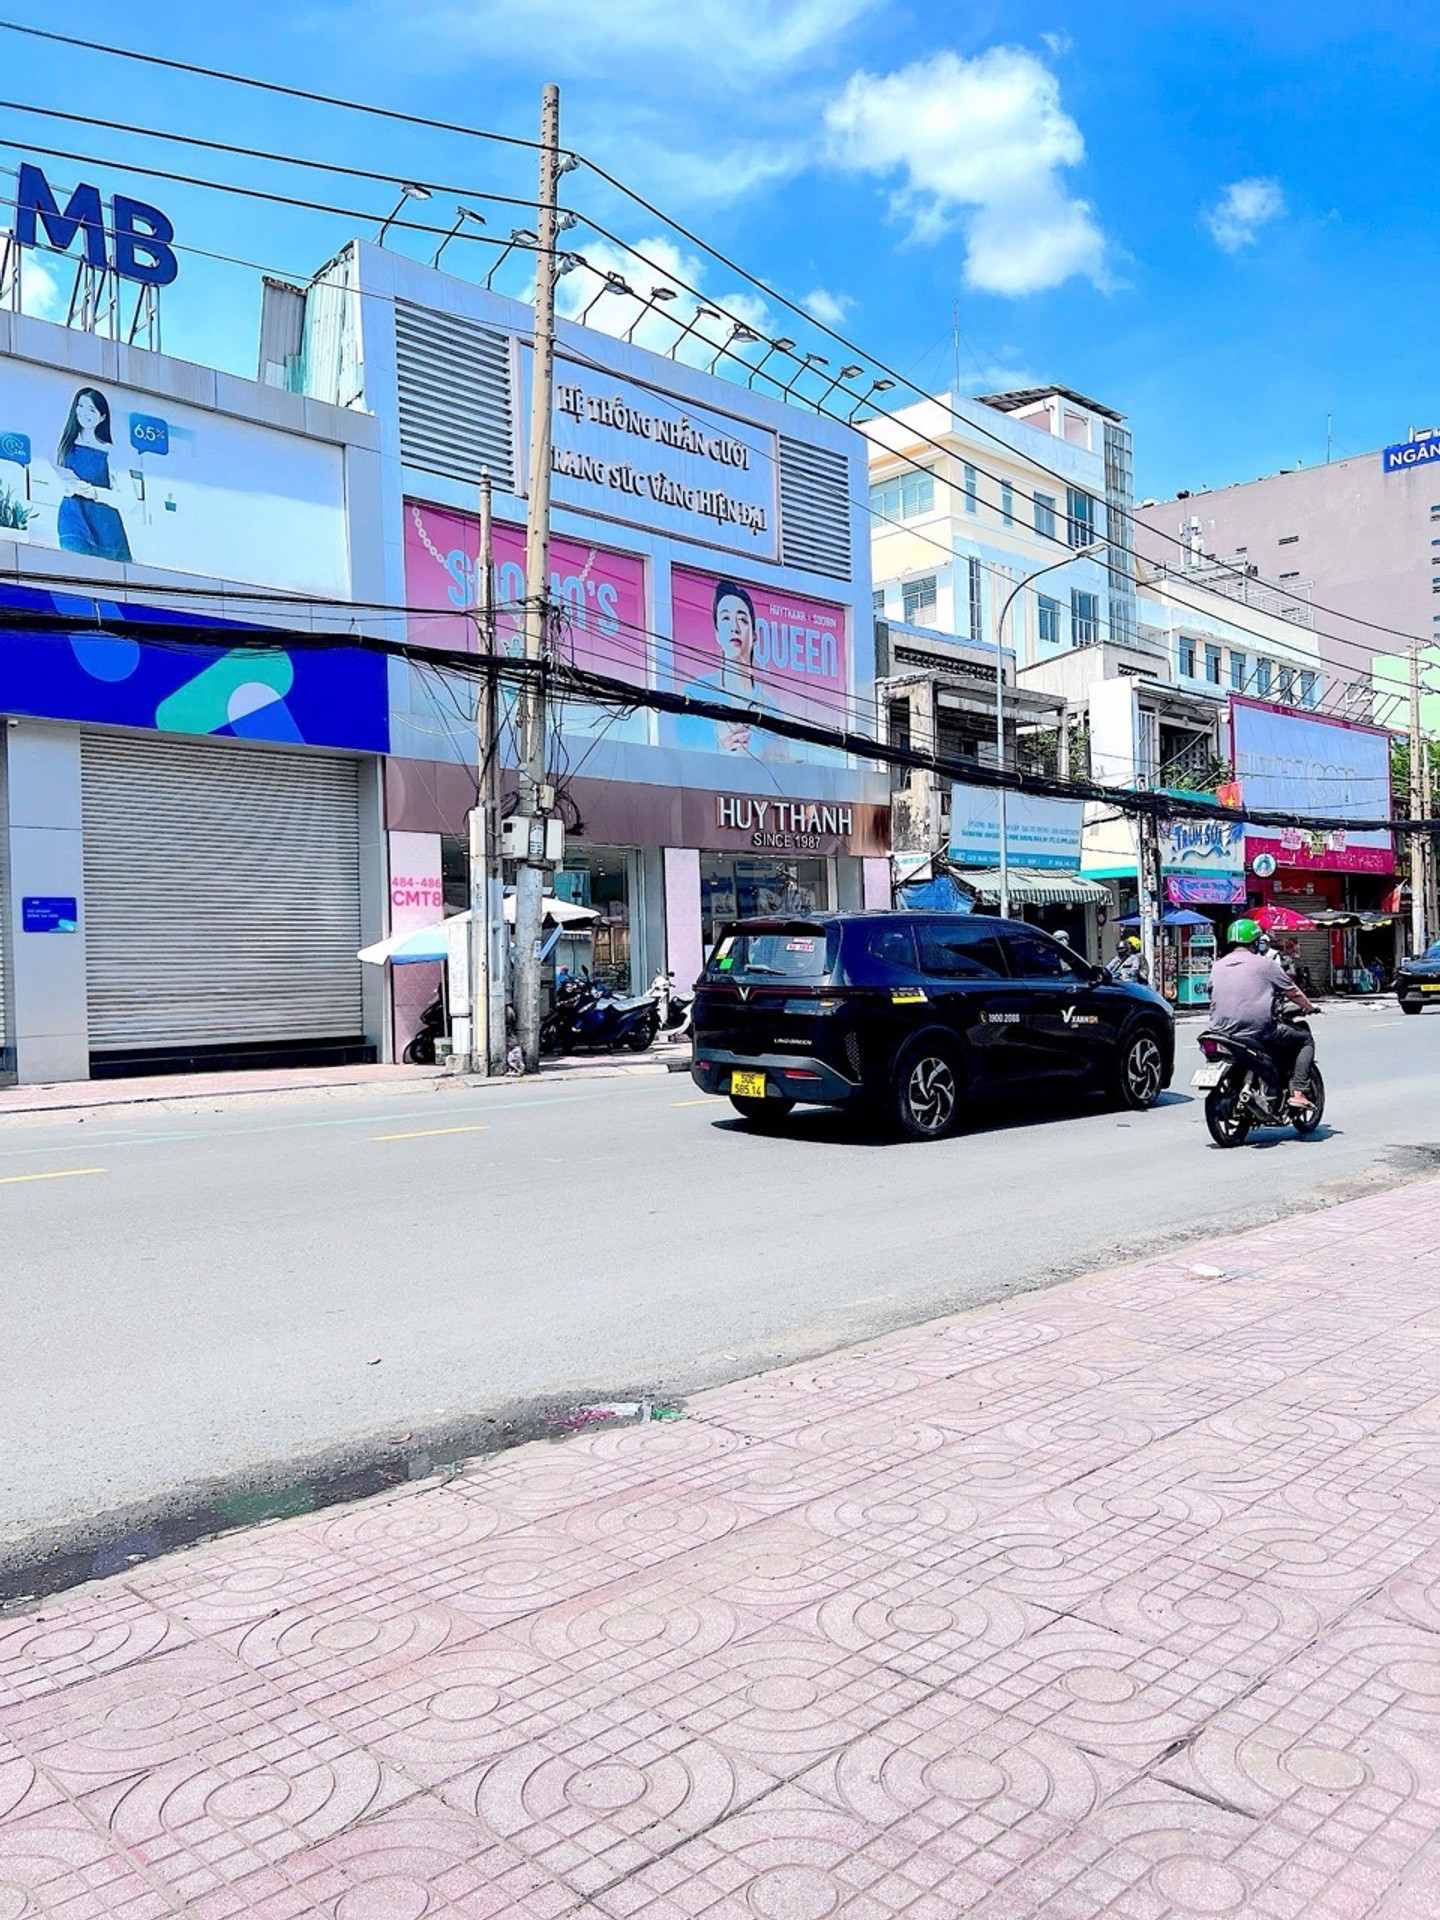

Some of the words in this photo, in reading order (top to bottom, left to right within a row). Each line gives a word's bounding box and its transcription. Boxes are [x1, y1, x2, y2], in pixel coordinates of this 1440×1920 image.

[15, 162, 178, 287] MB
[557, 385, 584, 424] HỆ
[586, 392, 653, 439] THỐNG
[551, 444, 605, 485] RANG
[646, 472, 693, 511] VÀNG
[1390, 442, 1440, 468] NGÂN
[753, 617, 838, 678] QUEEN
[717, 796, 768, 830] HUY
[773, 802, 852, 836] THANH
[753, 832, 792, 848] SINCE
[795, 836, 821, 849] 1987
[392, 890, 442, 907] CMT8
